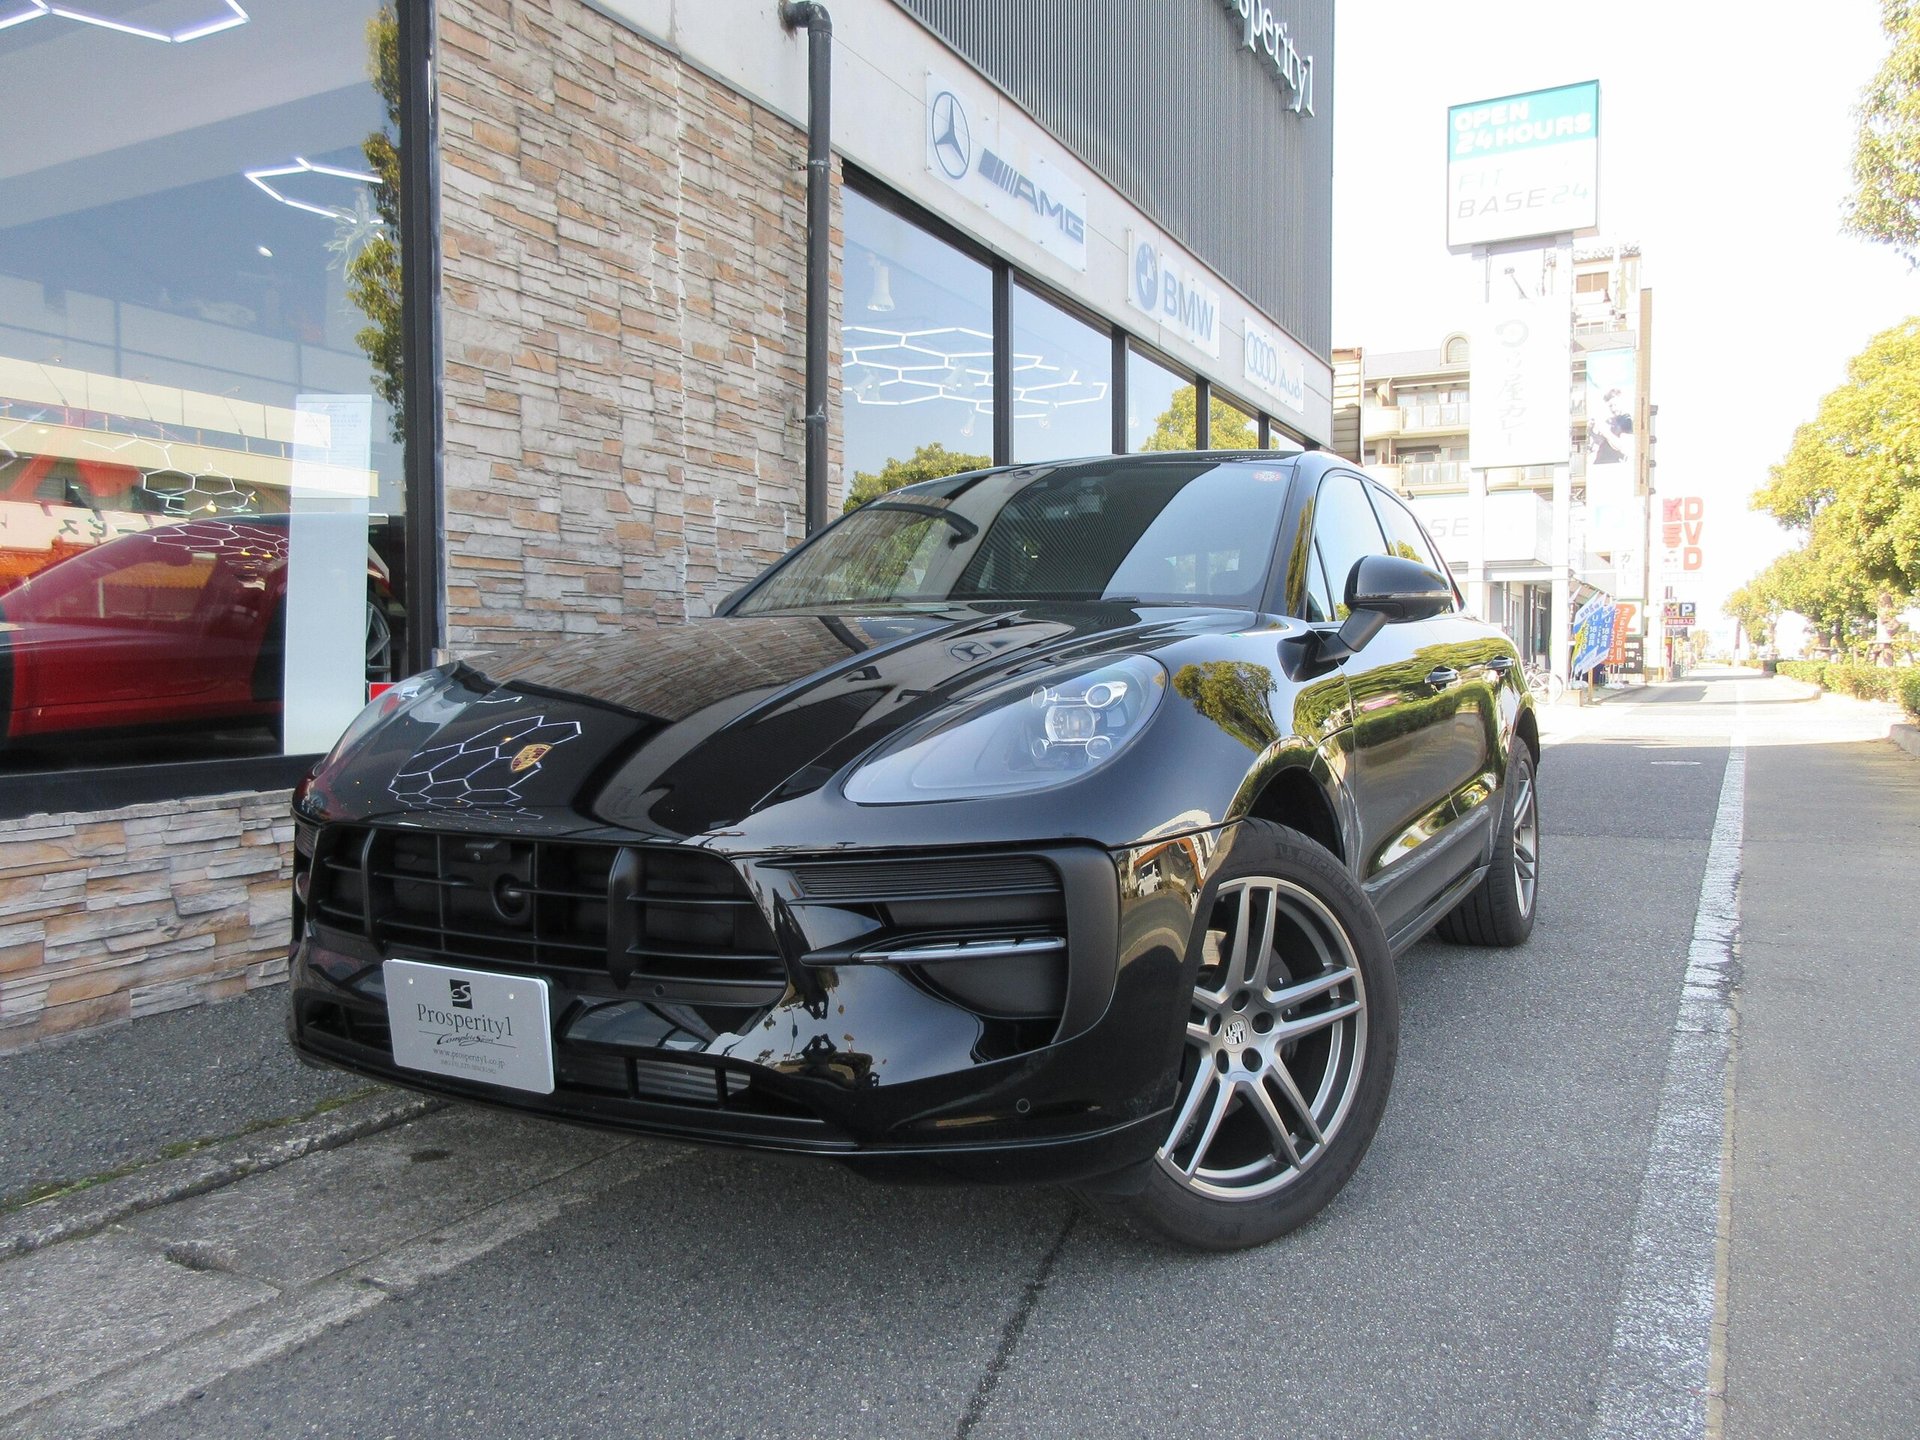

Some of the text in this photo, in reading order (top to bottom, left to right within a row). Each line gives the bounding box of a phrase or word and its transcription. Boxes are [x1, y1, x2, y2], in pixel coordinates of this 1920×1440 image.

[1455, 102, 1529, 131] OPEN
[1458, 168, 1504, 192] FIT
[1013, 180, 1084, 245] AMG
[1163, 269, 1214, 342] BMW
[1280, 369, 1303, 400] Audi
[1683, 497, 1704, 571] DVD
[1681, 604, 1693, 617] P
